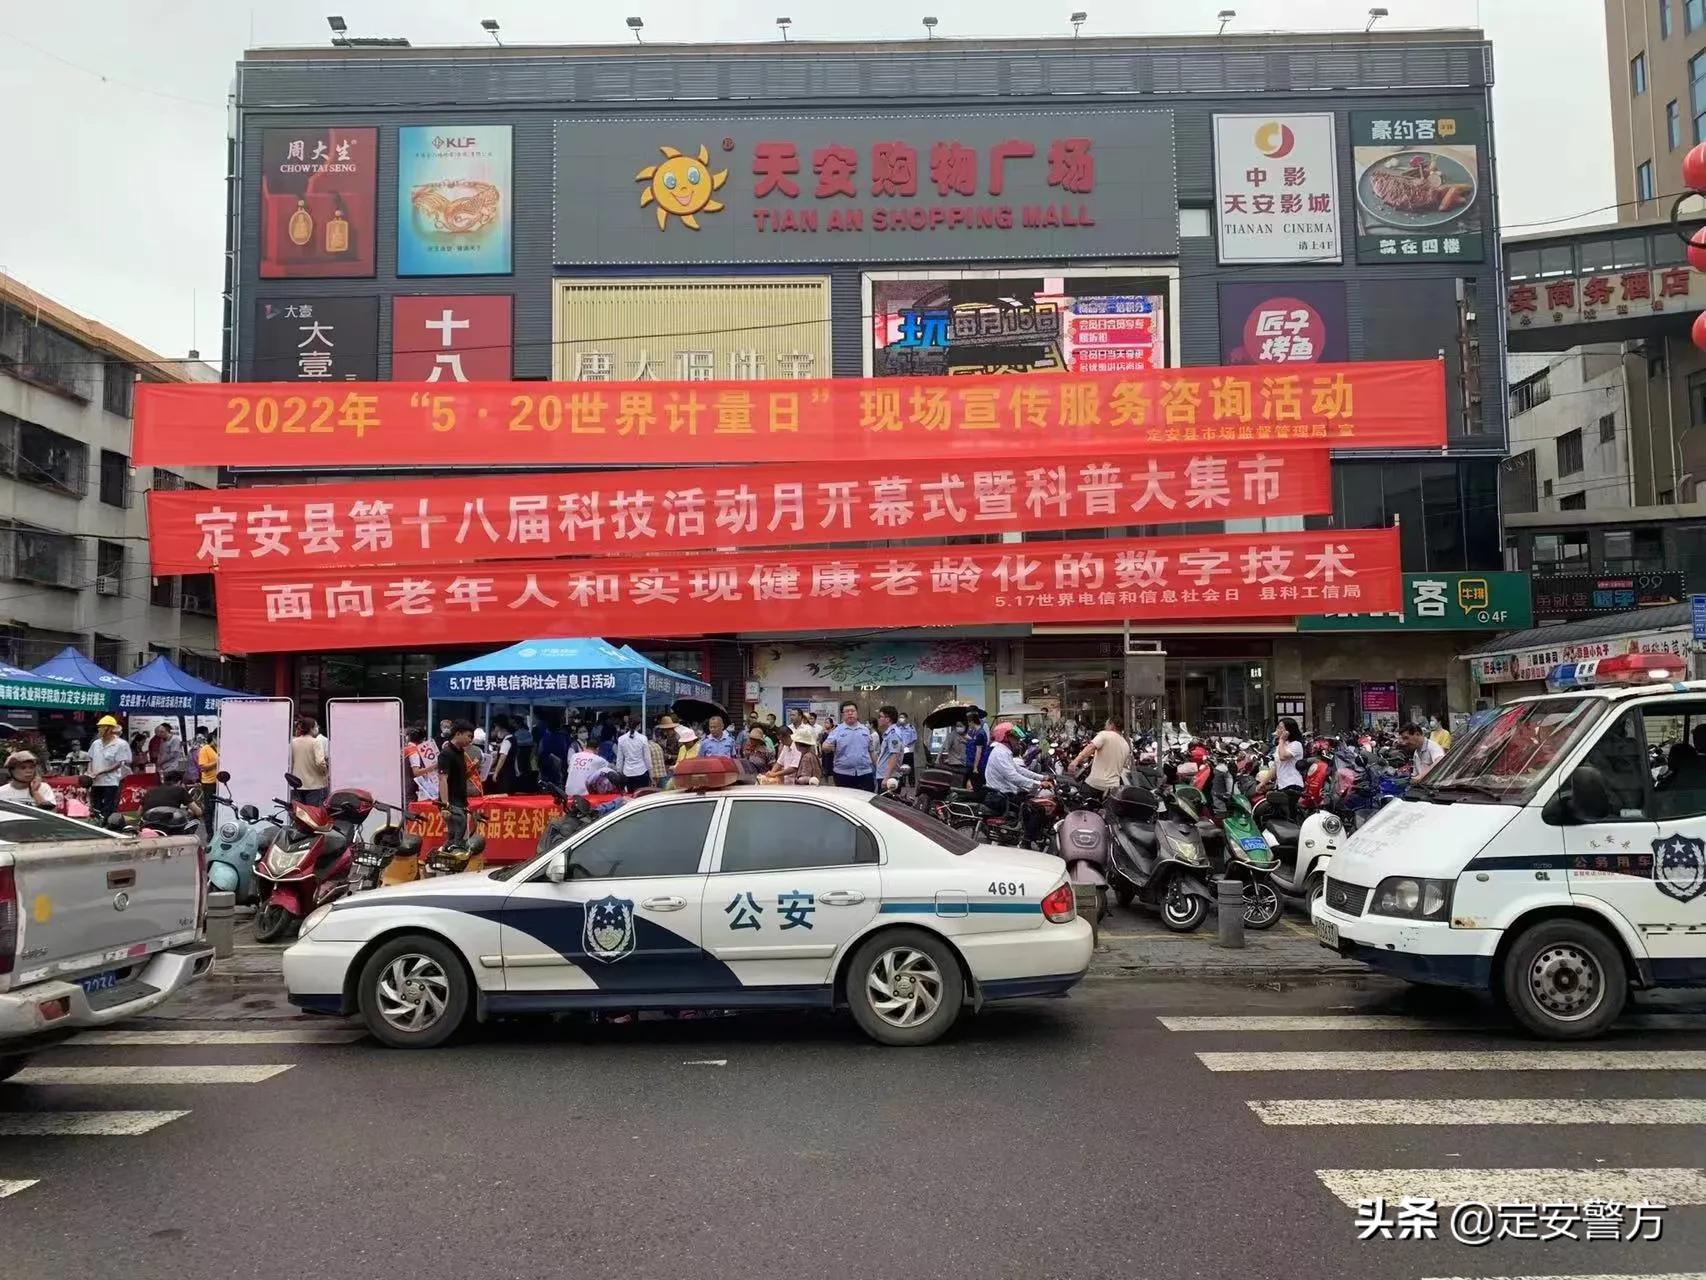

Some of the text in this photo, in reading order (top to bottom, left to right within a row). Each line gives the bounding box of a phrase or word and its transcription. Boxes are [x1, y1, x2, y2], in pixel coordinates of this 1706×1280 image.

[1371, 120, 1436, 140] 豪约客
[286, 139, 351, 161] 周大生
[446, 138, 476, 148] KLF
[752, 138, 1095, 198] 天安购物广场
[1246, 167, 1305, 187] 中影
[1225, 193, 1331, 214] 天安影城
[754, 205, 1096, 233] TIAN AN SHOPPING MALL
[1225, 222, 1334, 235] TIANAN CINEMA
[1379, 238, 1461, 255] 就在四楼
[1509, 267, 1690, 314] 安商务酒店
[284, 304, 313, 318] 大壹
[1256, 309, 1310, 336] 匠子
[1259, 335, 1314, 363] 烤鱼
[225, 392, 380, 438] 2022年
[860, 372, 1355, 433] 现场宣传服务咨询活动
[1147, 423, 1355, 442] 定安县市场监督管理局 宣
[195, 453, 1285, 560] 定安县第十八届科技活动月开幕式暨科普大集市
[262, 544, 1358, 623] 面向老年人和实现健康老龄化的数字技术
[995, 584, 1361, 608] 5.17世界电信和信息社会日 县科工信局
[1491, 610, 1508, 623] 4F
[450, 673, 616, 691] 5.17世界电信和社会信息日活动
[1575, 855, 1652, 869] 公务用车
[1535, 871, 1551, 881] CL
[987, 881, 1026, 897] 4691
[724, 888, 817, 932] 公安
